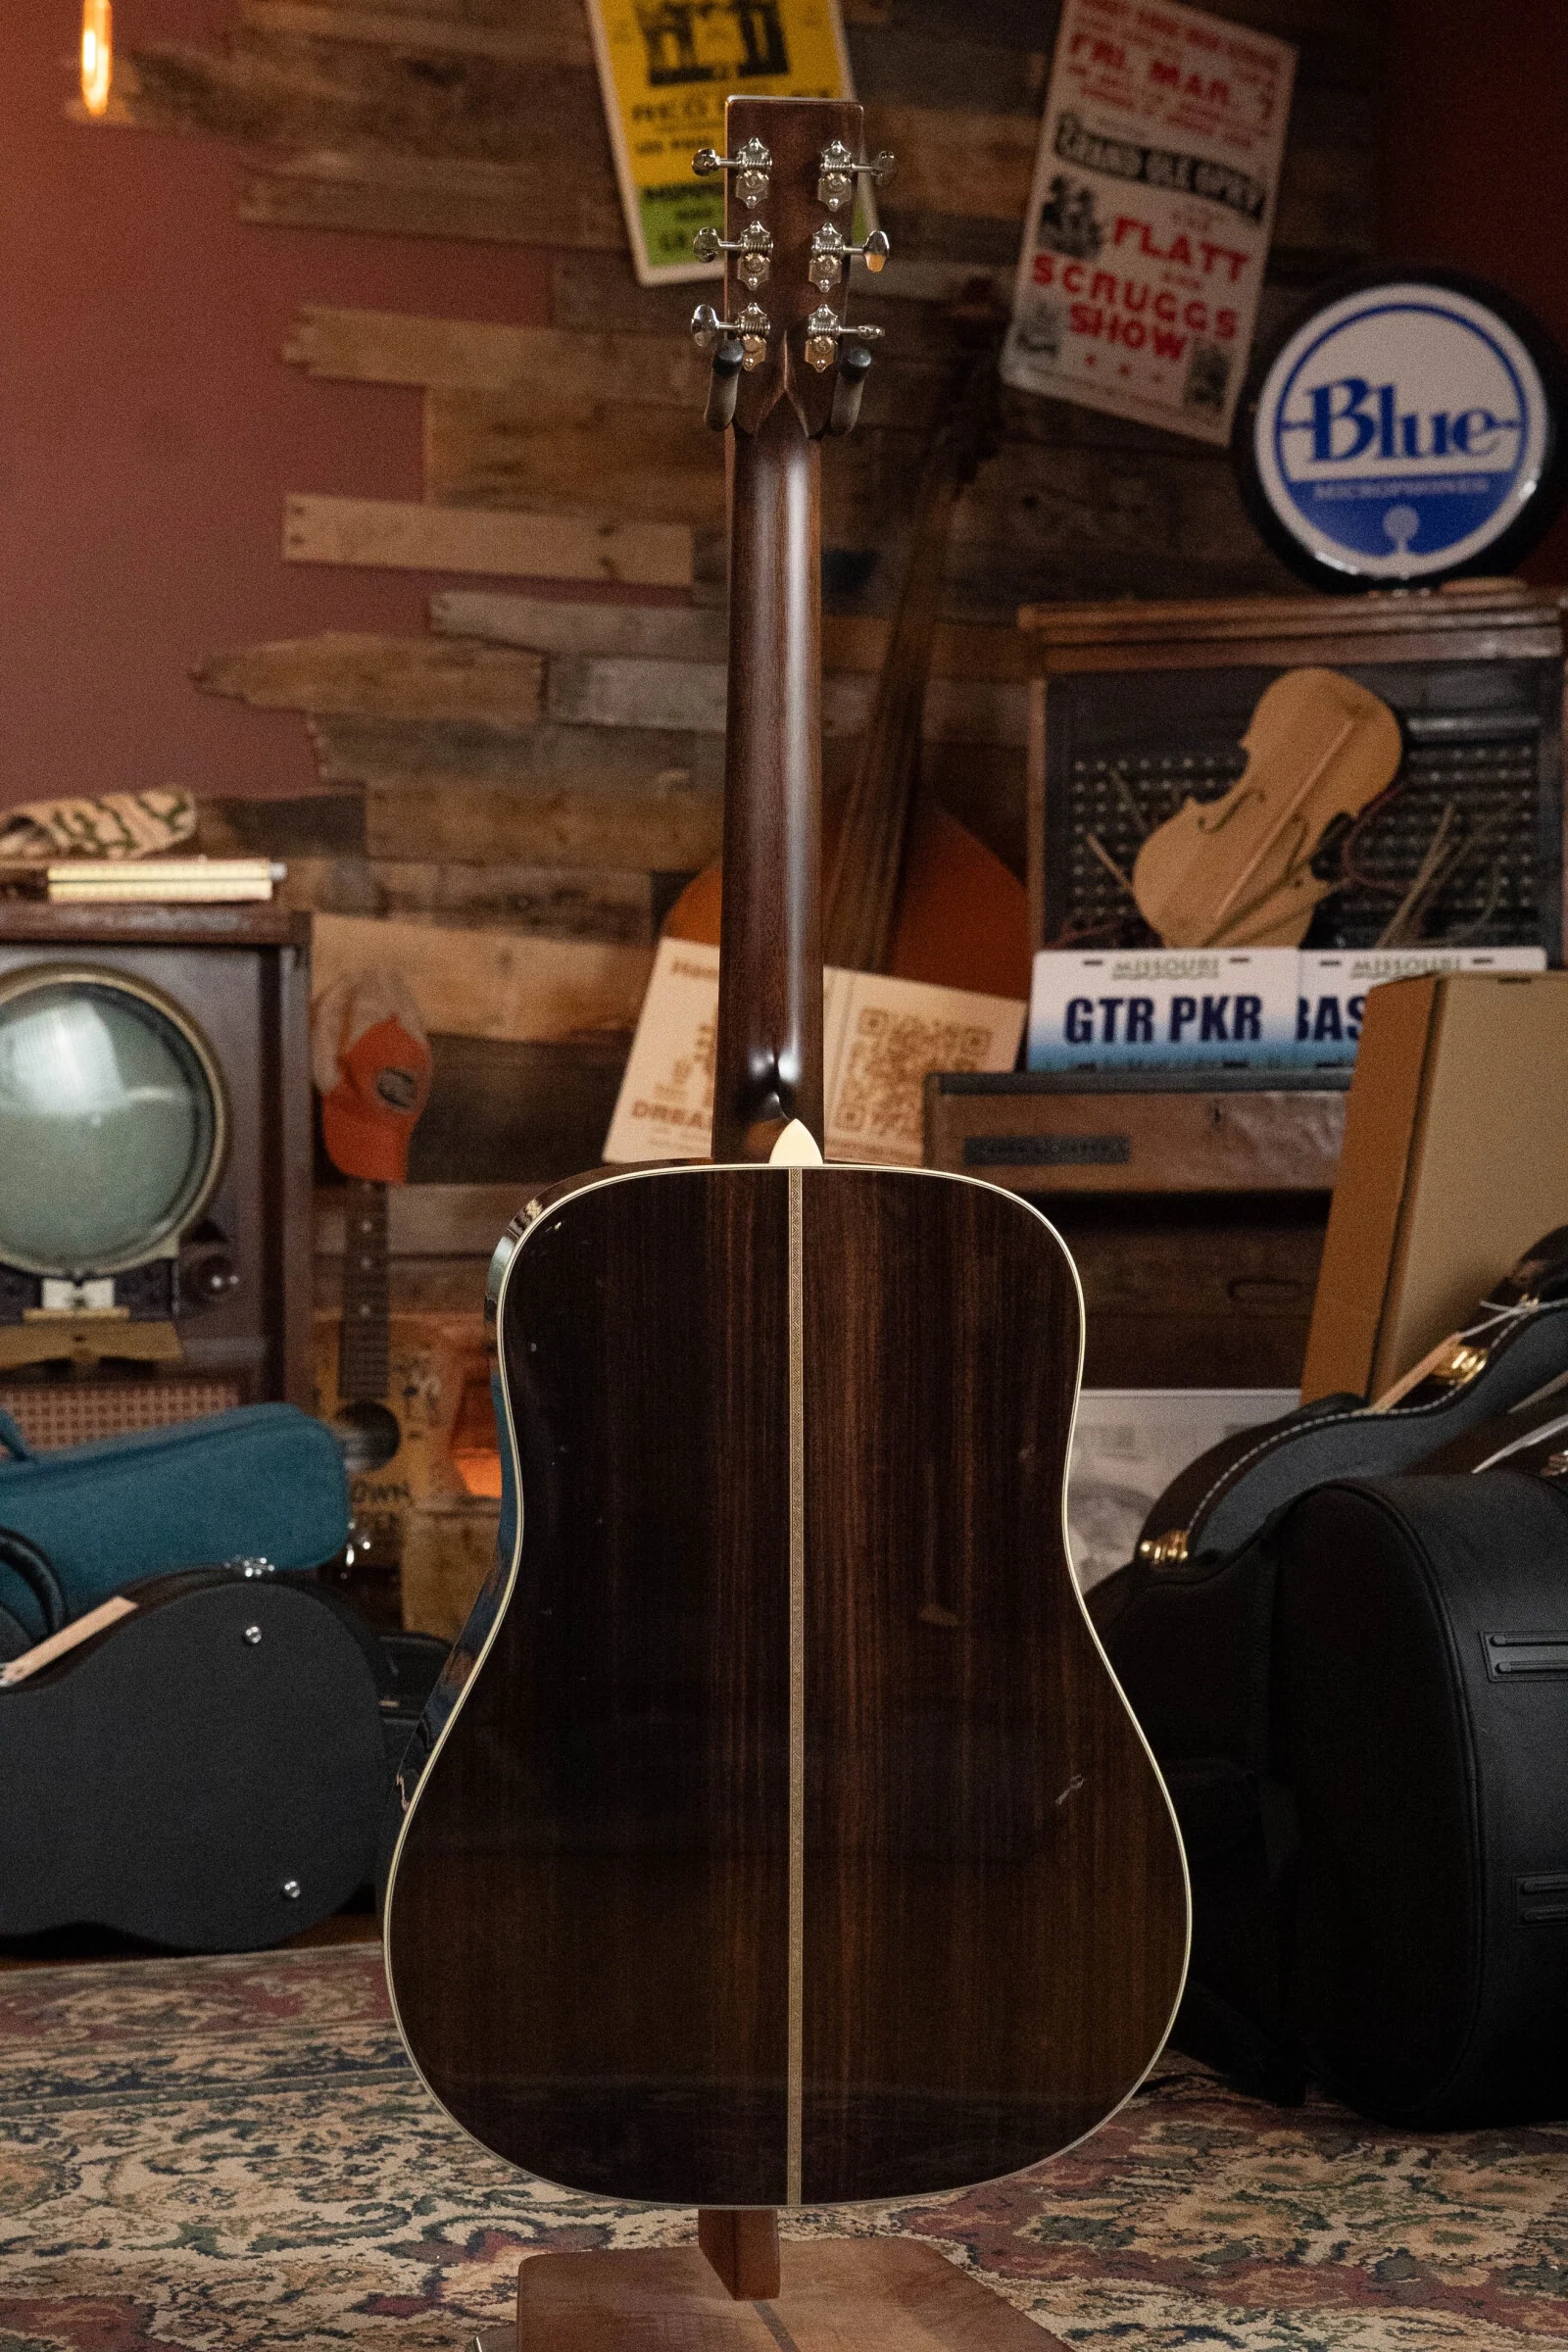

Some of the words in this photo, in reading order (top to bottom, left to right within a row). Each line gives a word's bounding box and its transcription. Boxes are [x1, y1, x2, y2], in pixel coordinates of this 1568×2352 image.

[1114, 217, 1249, 281] FLATT
[1033, 254, 1238, 340] SCRUGGS
[1068, 303, 1188, 362] SHOW
[1304, 375, 1502, 464] Blue
[1112, 958, 1219, 980] MISSOURI
[1064, 997, 1154, 1045] GTR
[1169, 995, 1262, 1044] PKR
